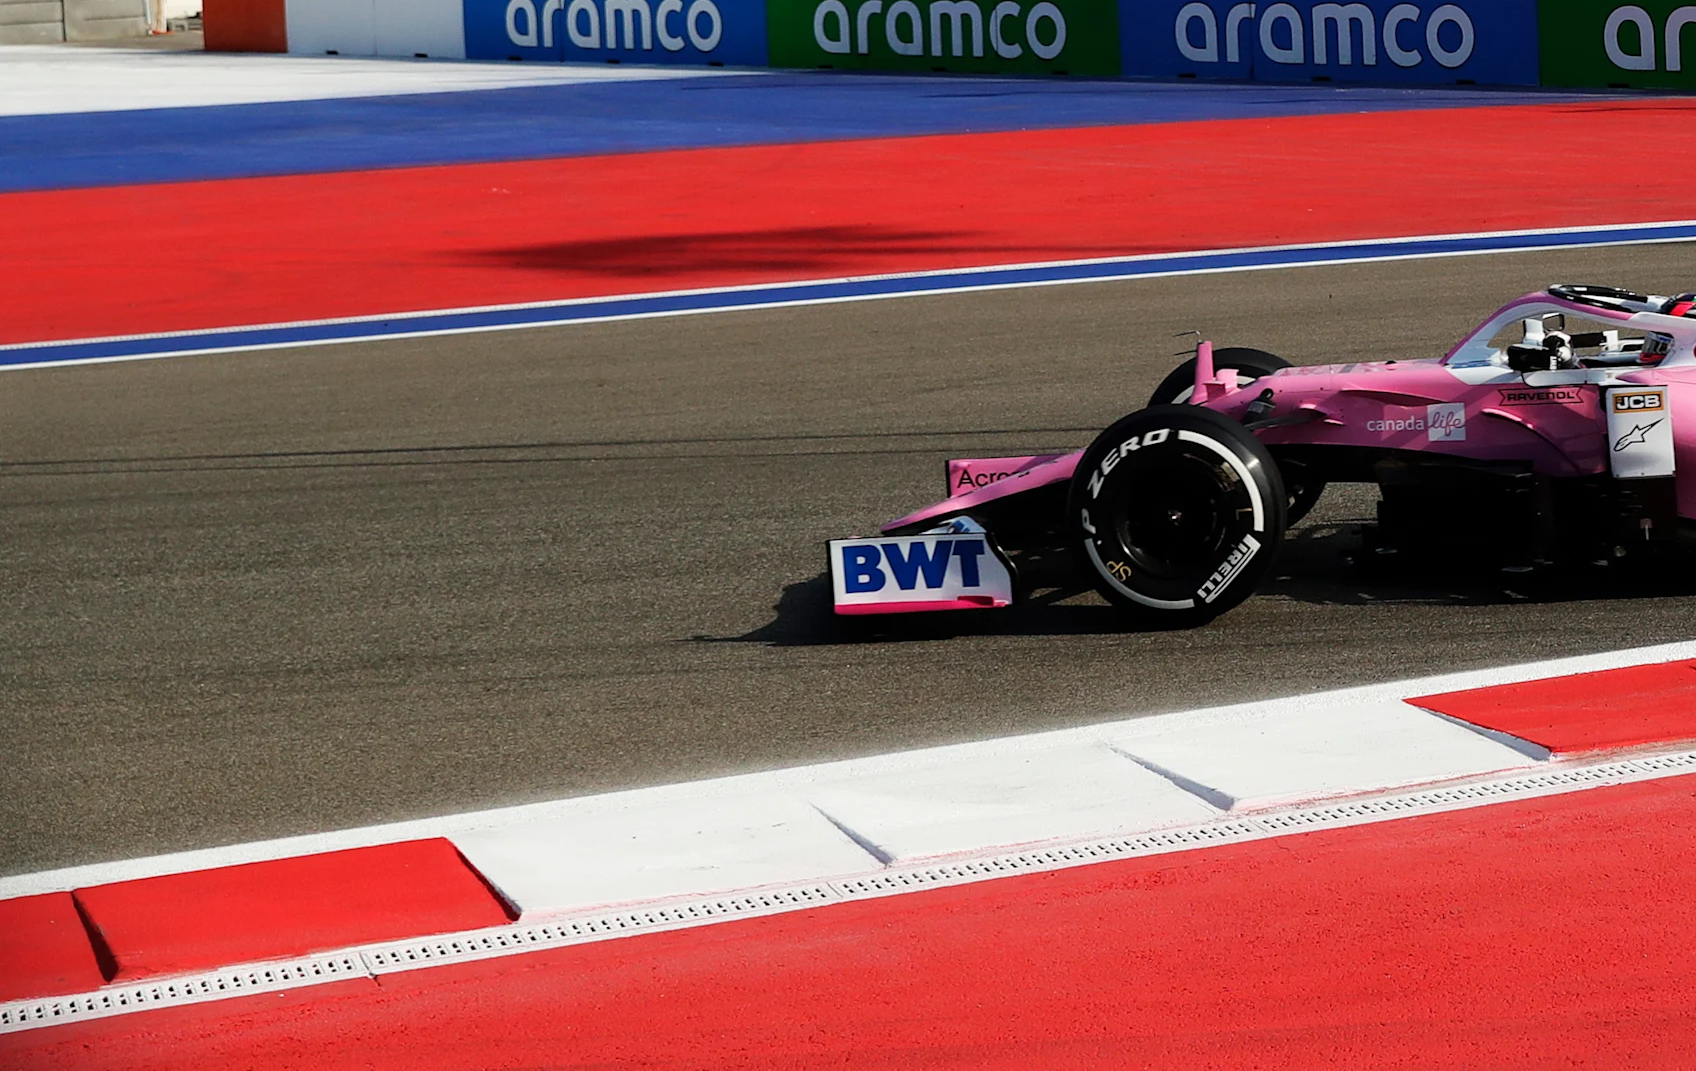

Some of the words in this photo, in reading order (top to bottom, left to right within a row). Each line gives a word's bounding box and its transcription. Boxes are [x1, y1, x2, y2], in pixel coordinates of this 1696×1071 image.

[814, 0, 1067, 60] aramco
[1175, 2, 1475, 68] aramco
[1366, 415, 1425, 431] canada
[1428, 411, 1465, 436] life
[1507, 391, 1576, 401] RAVENOL
[1616, 394, 1661, 409] JCB
[1087, 428, 1170, 499] ZERO
[844, 539, 985, 593] BWT
[1196, 533, 1261, 604] PIRELLI
